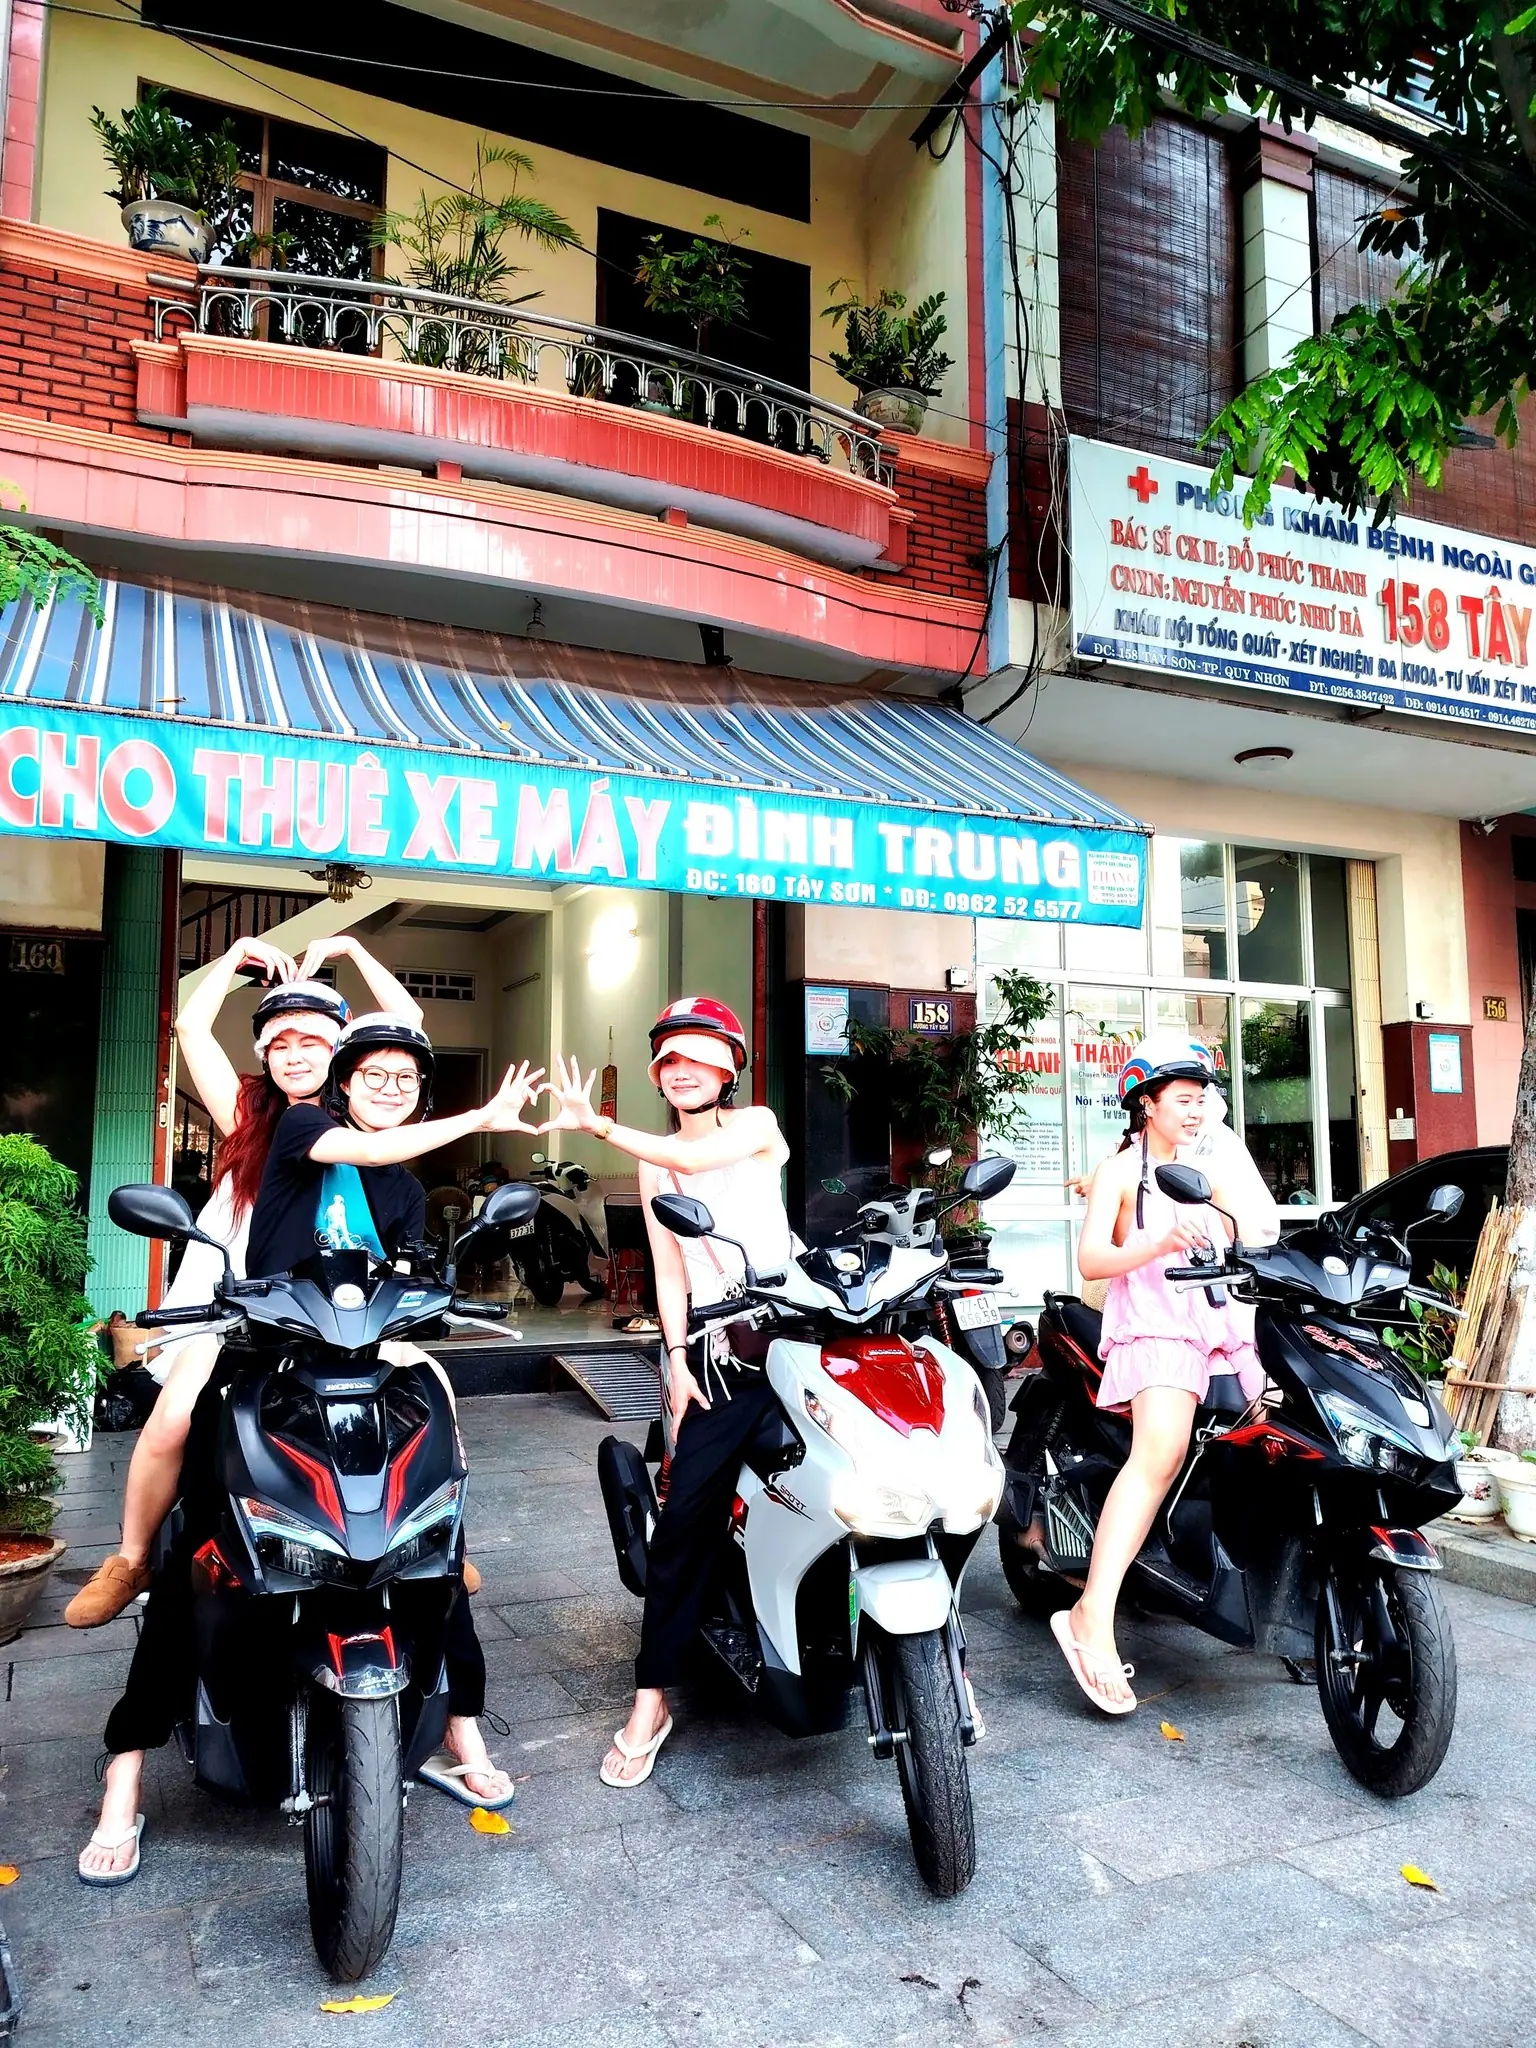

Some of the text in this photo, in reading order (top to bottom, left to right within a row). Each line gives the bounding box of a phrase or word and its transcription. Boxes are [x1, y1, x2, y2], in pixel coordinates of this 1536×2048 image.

[1109, 516, 1148, 551] BÁC
[1152, 525, 1172, 557] SĨ
[1228, 537, 1255, 574] ĐỖ
[1257, 551, 1305, 584] PHÚC
[1308, 563, 1368, 598] THANH
[1283, 507, 1359, 546] KHÁM
[1366, 525, 1434, 562] BỆNH
[1441, 545, 1513, 580] NGOÀI
[1110, 564, 1365, 637] CNXN: NGUYỄN PHÚC NHƯ HÀ
[1376, 577, 1533, 669] 158 TÂY
[1093, 642, 1115, 657] ĐC:
[1119, 648, 1139, 661] 158
[1143, 650, 1168, 666] TÂY
[1224, 665, 1251, 681] QUY
[1254, 670, 1291, 688] NHƠN
[1308, 680, 1328, 694] ĐT:
[1488, 712, 1536, 729] 0914.46276
[1114, 608, 1161, 637] KHÁM
[1165, 615, 1193, 648] NỘI
[1196, 617, 1239, 652] TỔNG
[1288, 639, 1317, 665] XÉT
[1319, 647, 1374, 679] NGHIỆM
[1378, 657, 1398, 680] ĐA
[1401, 662, 1438, 687] KHOA
[1445, 669, 1464, 691] TƯ
[1466, 670, 1491, 697] VẤN
[1493, 676, 1518, 702] XÉT
[0, 726, 1082, 889] CHO THUÊ XE MÁY ĐÌNH TRUNG
[686, 868, 1082, 920] ĐC: 160 TÂY SƠN DĐ: 0962 52 5577
[16, 941, 62, 969] 160
[914, 1002, 950, 1025] 158
[1485, 999, 1505, 1018] 156
[779, 1484, 807, 1511] SPORT
